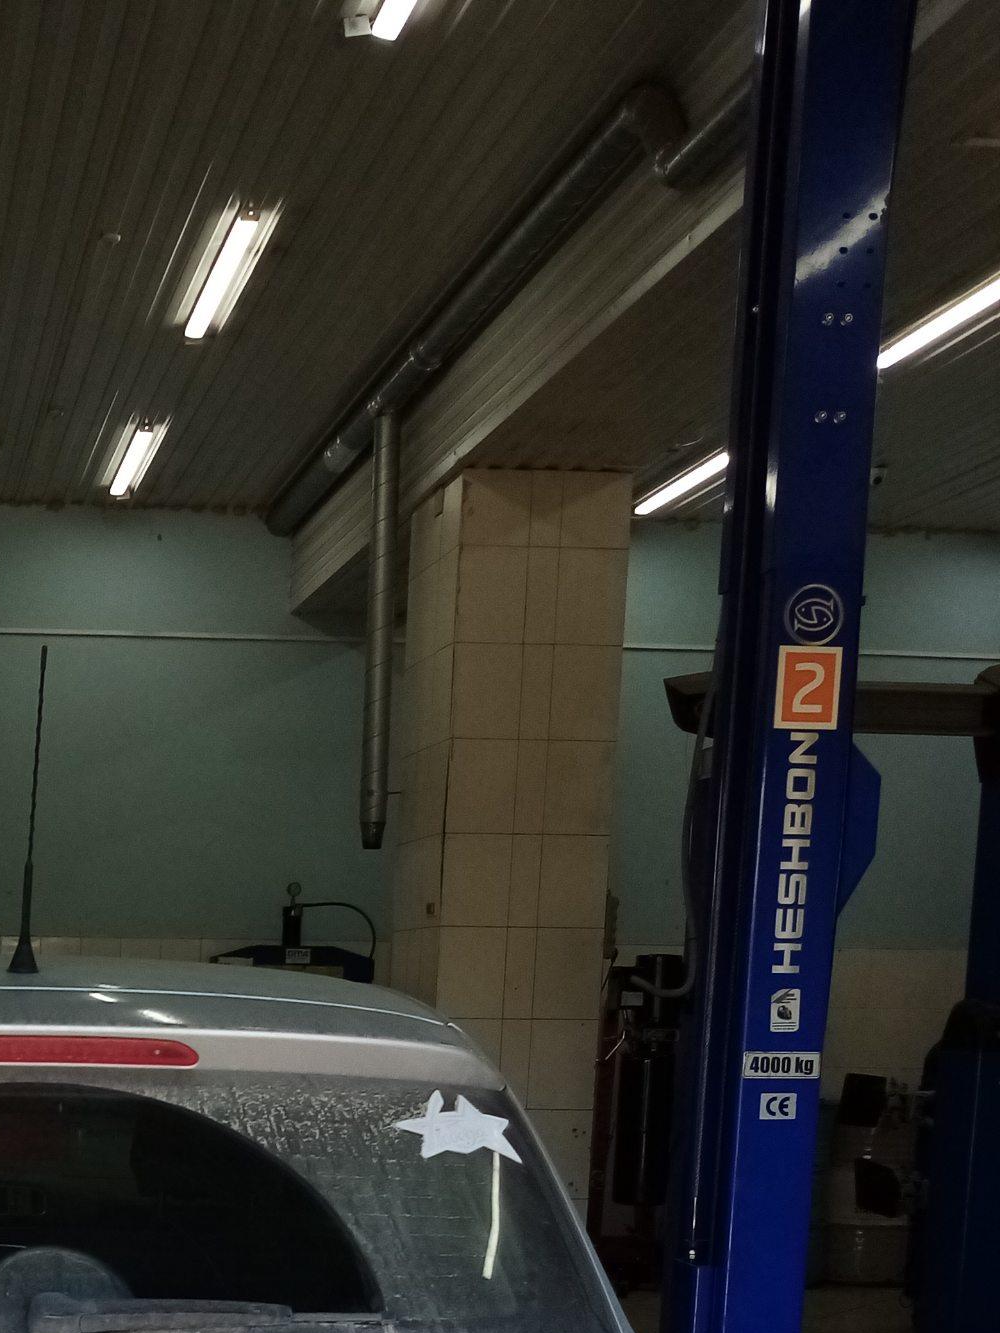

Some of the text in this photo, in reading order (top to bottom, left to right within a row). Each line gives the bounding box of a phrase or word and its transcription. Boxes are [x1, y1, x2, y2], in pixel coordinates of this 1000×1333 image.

[792, 662, 825, 713] 2
[771, 731, 819, 974] HESHBON
[750, 1056, 814, 1075] 4000 kg
[765, 1096, 791, 1117] CE
